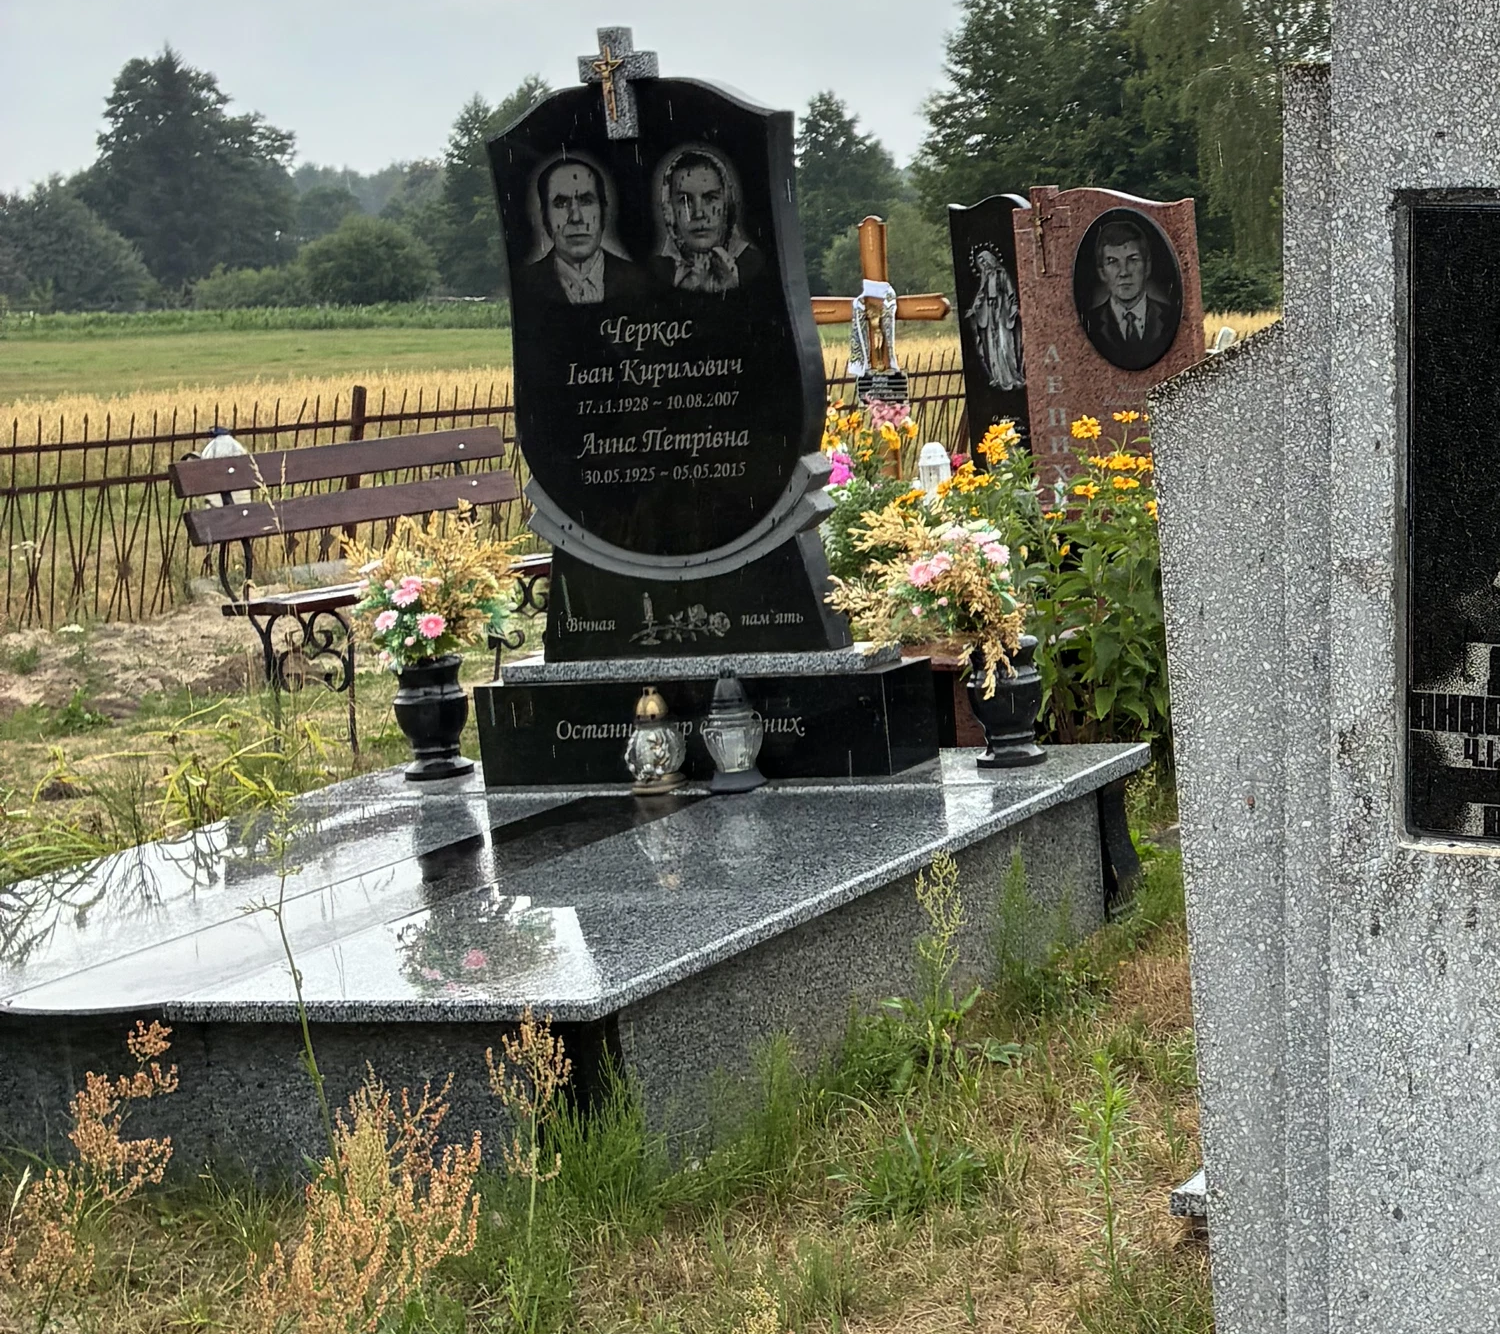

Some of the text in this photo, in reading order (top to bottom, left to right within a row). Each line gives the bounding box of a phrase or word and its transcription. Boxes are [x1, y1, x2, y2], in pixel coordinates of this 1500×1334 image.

[600, 316, 693, 351] Черкас
[566, 357, 744, 388] Іван Кирилович
[577, 396, 650, 415] 17.11.1928
[667, 391, 740, 410] 10.08.2007
[577, 425, 751, 460] Анна Петрівна
[585, 467, 656, 485] 30.05.1925
[673, 462, 746, 481] 05.05.2015
[567, 618, 617, 632] Вічная
[556, 720, 635, 740] Останн
